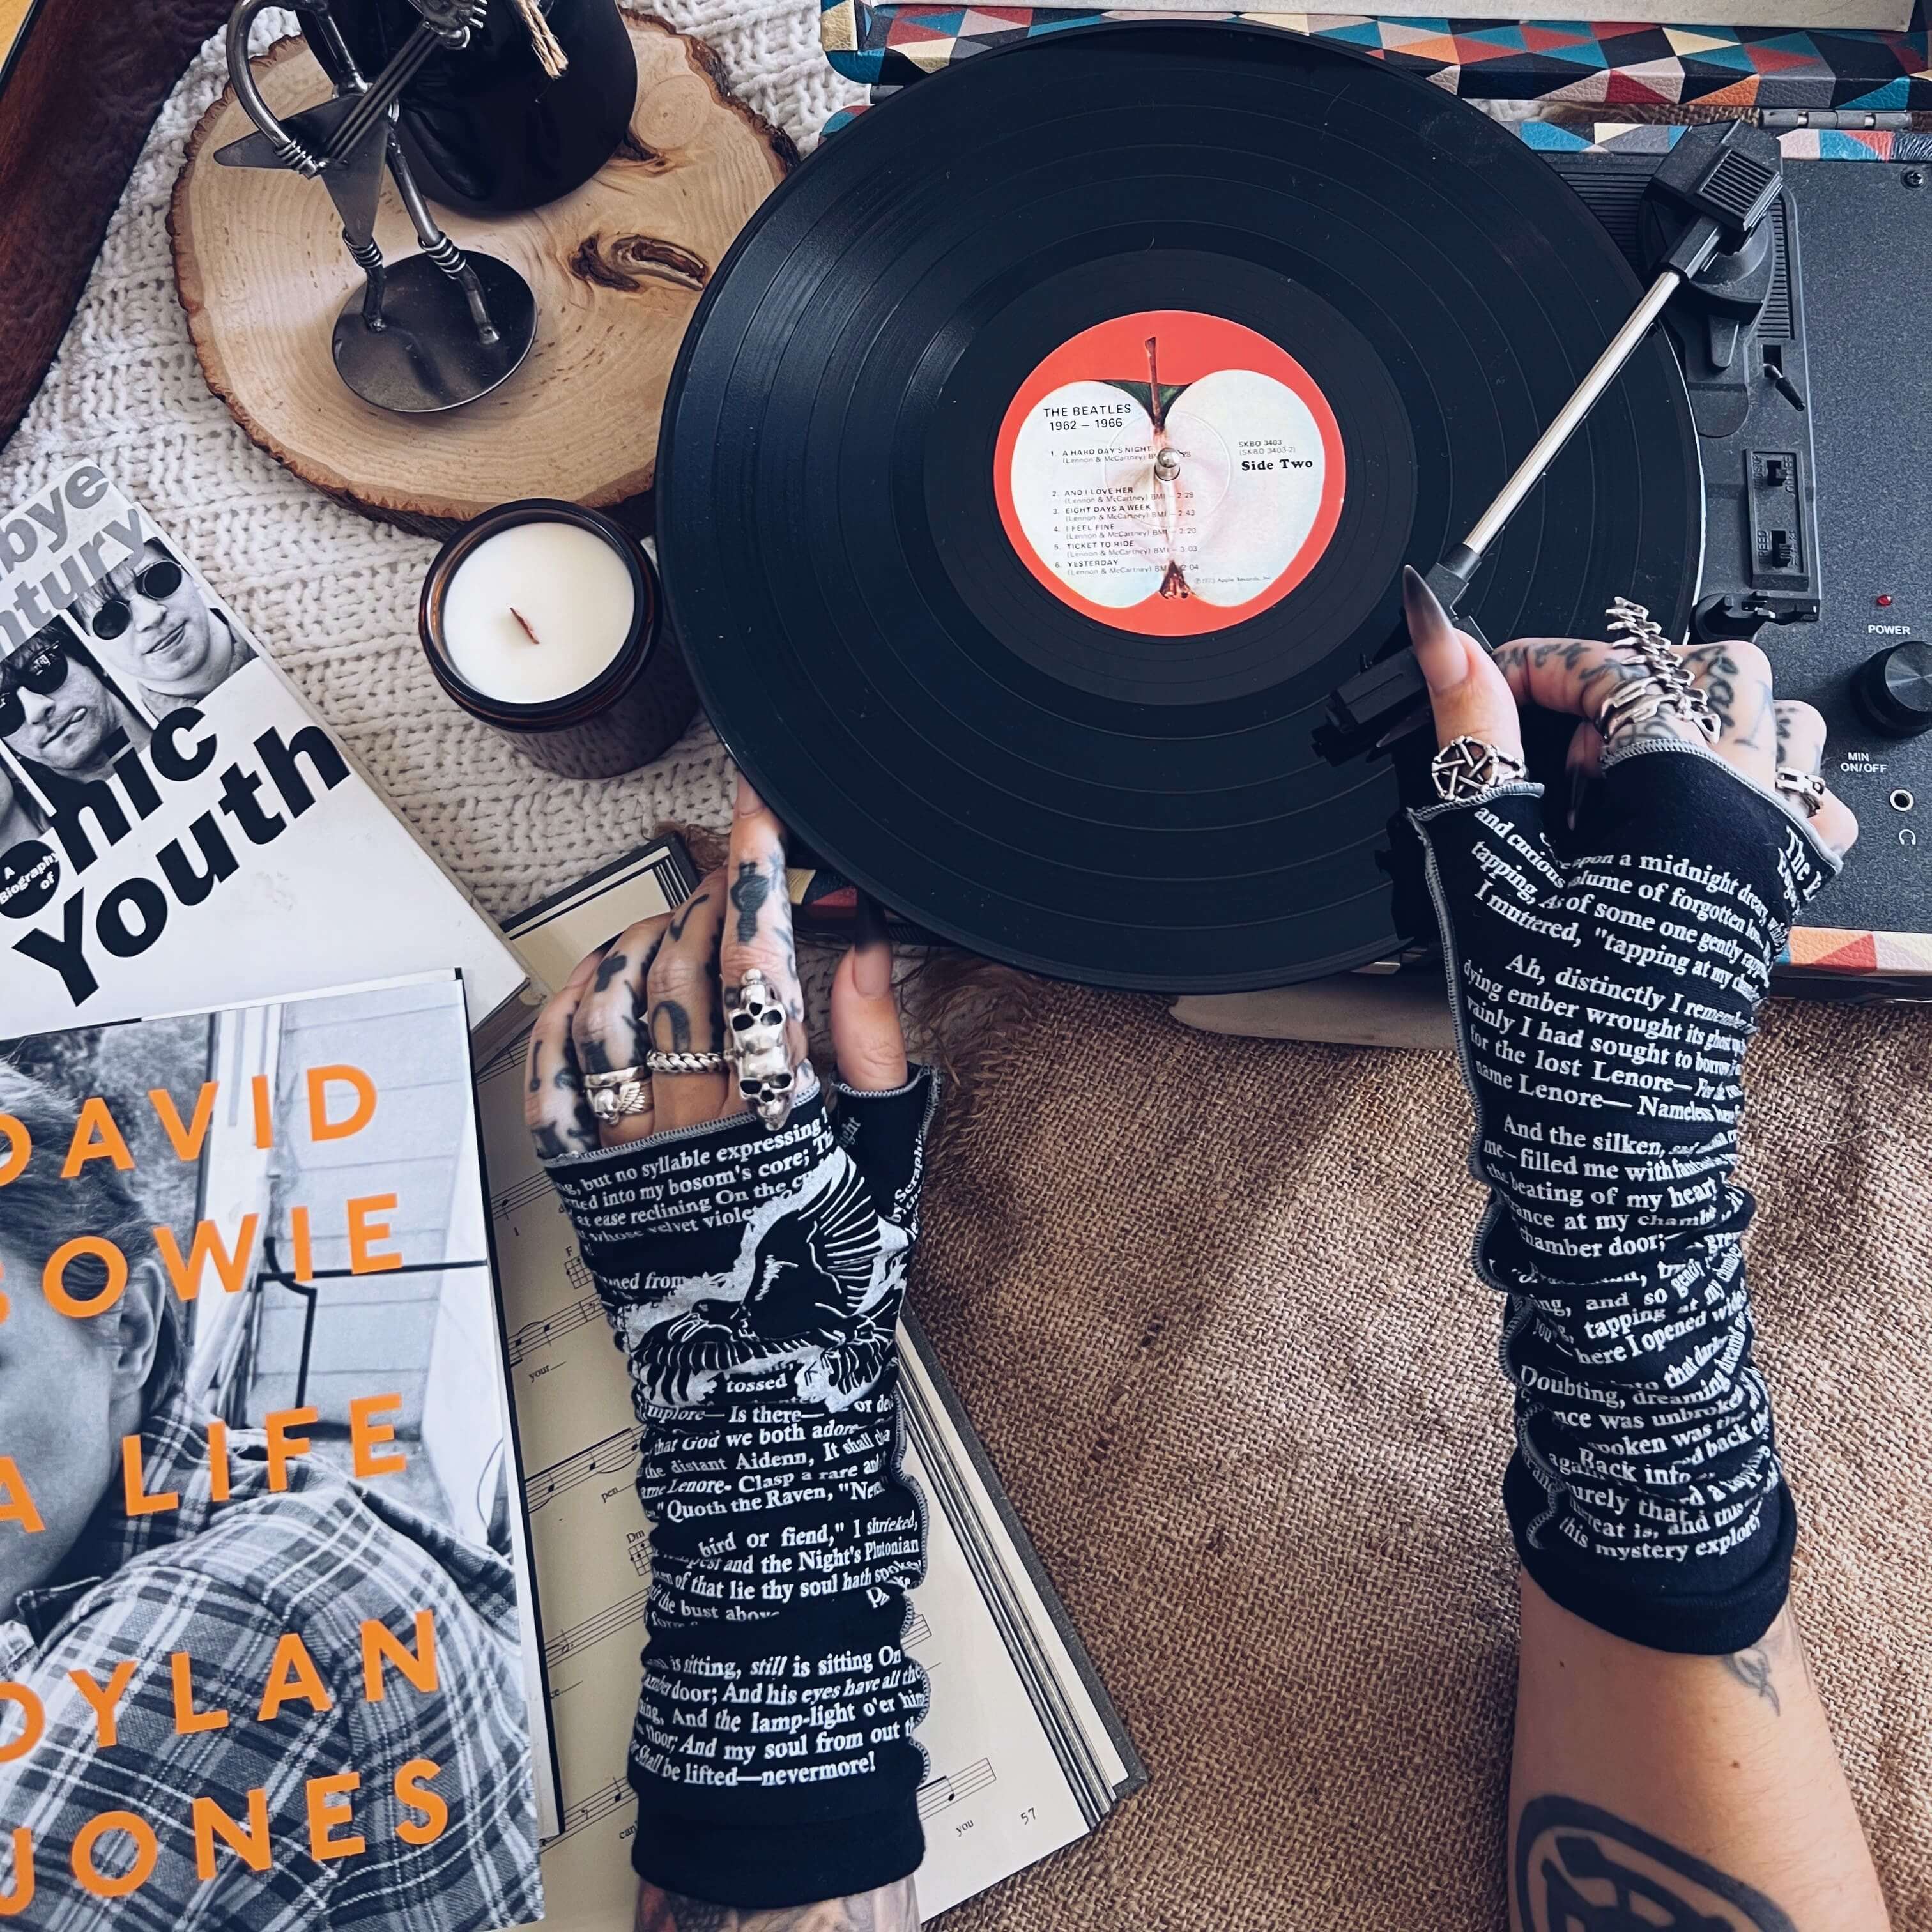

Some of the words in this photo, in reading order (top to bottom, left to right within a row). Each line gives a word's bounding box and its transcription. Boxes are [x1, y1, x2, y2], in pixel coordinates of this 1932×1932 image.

[1044, 407, 1068, 417] THE
[1073, 404, 1131, 416] BEATLES
[1050, 420, 1077, 431] 1962
[1095, 418, 1123, 429] 1966
[1241, 460, 1274, 471] Side
[1279, 459, 1313, 469] Two
[1106, 494, 1148, 502] McCartney)
[1107, 512, 1149, 520] McCartney)
[1108, 530, 1150, 538] McCartney)
[1068, 559, 1119, 567] YESTERDAY
[1108, 548, 1151, 556] McCartney)
[1109, 565, 1151, 574] McCartney)
[1868, 625, 1910, 635] POWER
[1841, 762, 1887, 773] ON/OFF
[1848, 752, 1869, 762] MIN
[1474, 807, 1515, 838] and
[4, 866, 15, 880] A
[12, 725, 350, 1008] Youth
[40, 871, 55, 890] of
[1471, 841, 1539, 905] tapping,
[1619, 854, 1632, 866] a
[1639, 854, 1739, 895] midnight
[1637, 882, 1669, 903] of
[1669, 887, 1746, 934] forgotten
[1487, 894, 1581, 948] muttered,
[1595, 927, 1690, 976] "tapping
[1692, 960, 1712, 978] at
[1565, 894, 1595, 914] of
[1594, 902, 1656, 931] some
[1659, 921, 1698, 944] one
[1697, 931, 1744, 965] gently
[1505, 953, 1545, 986] Ah,
[1554, 967, 1666, 1013] distinctly
[1668, 992, 1685, 1013] I
[1464, 959, 1504, 1002] dying
[1507, 988, 1580, 1018] ember
[1586, 1007, 1683, 1040] wrought
[1466, 995, 1515, 1035] vainly
[1519, 1016, 1534, 1038] I
[1537, 1021, 1584, 1049] had
[1590, 1038, 1671, 1066] sought
[1675, 1050, 1694, 1070] to
[1471, 1023, 1489, 1051] for
[1495, 1039, 1526, 1064] the
[1535, 1050, 1583, 1077] lost
[1476, 1060, 1513, 1089] name
[1637, 1095, 1715, 1122] Nameless
[1503, 1114, 1544, 1141] And
[1549, 1126, 1586, 1148] the
[1592, 1131, 1666, 1158] silken,
[579, 1174, 612, 1191] but
[615, 1167, 638, 1182] no
[641, 1149, 711, 1179] syllable
[716, 1118, 822, 1162] expressing
[1520, 1147, 1579, 1175] filled
[1583, 1162, 1620, 1179] me
[1624, 1160, 1675, 1182] with
[602, 1188, 636, 1207] into
[640, 1184, 664, 1201] my
[670, 1165, 752, 1195] bosom's
[758, 1150, 810, 1177] core;
[1509, 1170, 1584, 1207] beating
[1590, 1186, 1619, 1206] of
[1627, 1193, 1663, 1212] my
[594, 1213, 627, 1227] ease
[631, 1197, 712, 1223] reclining
[716, 1190, 749, 1205] On
[753, 1182, 786, 1199] the
[565, 1246, 573, 1257] F
[1519, 1225, 1604, 1258] chamber
[0, 1193, 402, 1324] OWIE
[1584, 1308, 1666, 1339] tapping
[528, 1363, 551, 1381] your
[726, 1373, 788, 1393] tossed
[1521, 1365, 1626, 1409] Doubting,
[728, 1406, 747, 1423] Is
[726, 1432, 753, 1447] we
[759, 1423, 806, 1445] both
[0, 1457, 45, 1532] A
[122, 1393, 407, 1517] LIFE
[671, 1457, 728, 1473] distant
[736, 1451, 815, 1470] Aidenn,
[823, 1442, 840, 1461] It
[842, 1432, 875, 1455] shall
[601, 1487, 619, 1503] pen
[739, 1473, 795, 1493] Clasp
[730, 1496, 762, 1512] the
[765, 1486, 834, 1508] Raven,
[626, 1530, 645, 1543] Dm
[698, 1531, 737, 1558] bird
[746, 1532, 770, 1549] or
[723, 1554, 754, 1574] and
[761, 1553, 792, 1574] the
[797, 1545, 862, 1572] Night's
[864, 1536, 920, 1561] Plutonian
[1595, 1543, 1689, 1562] mystery
[691, 1575, 724, 1598] that
[730, 1580, 755, 1600] lie
[760, 1579, 795, 1604] thy
[799, 1574, 838, 1597] soul
[680, 1599, 719, 1619] bust
[684, 1653, 742, 1680] sitting,
[750, 1655, 788, 1676] still
[792, 1655, 811, 1677] is
[817, 1650, 874, 1676] sitting
[671, 1680, 717, 1705] door;
[721, 1681, 763, 1703] And
[765, 1683, 798, 1705] his
[801, 1685, 841, 1705] eyes
[843, 1678, 880, 1697] have
[673, 1706, 708, 1728] And
[714, 1708, 742, 1733] the
[750, 1702, 856, 1735] lamp-light
[863, 1697, 896, 1717] o'er
[678, 1733, 717, 1757] And
[723, 1745, 756, 1765] my
[764, 1733, 808, 1760] soul
[815, 1731, 864, 1754] from
[955, 1818, 975, 1837] you
[1020, 1807, 1038, 1825] 57
[0, 1759, 448, 1915] JONES
